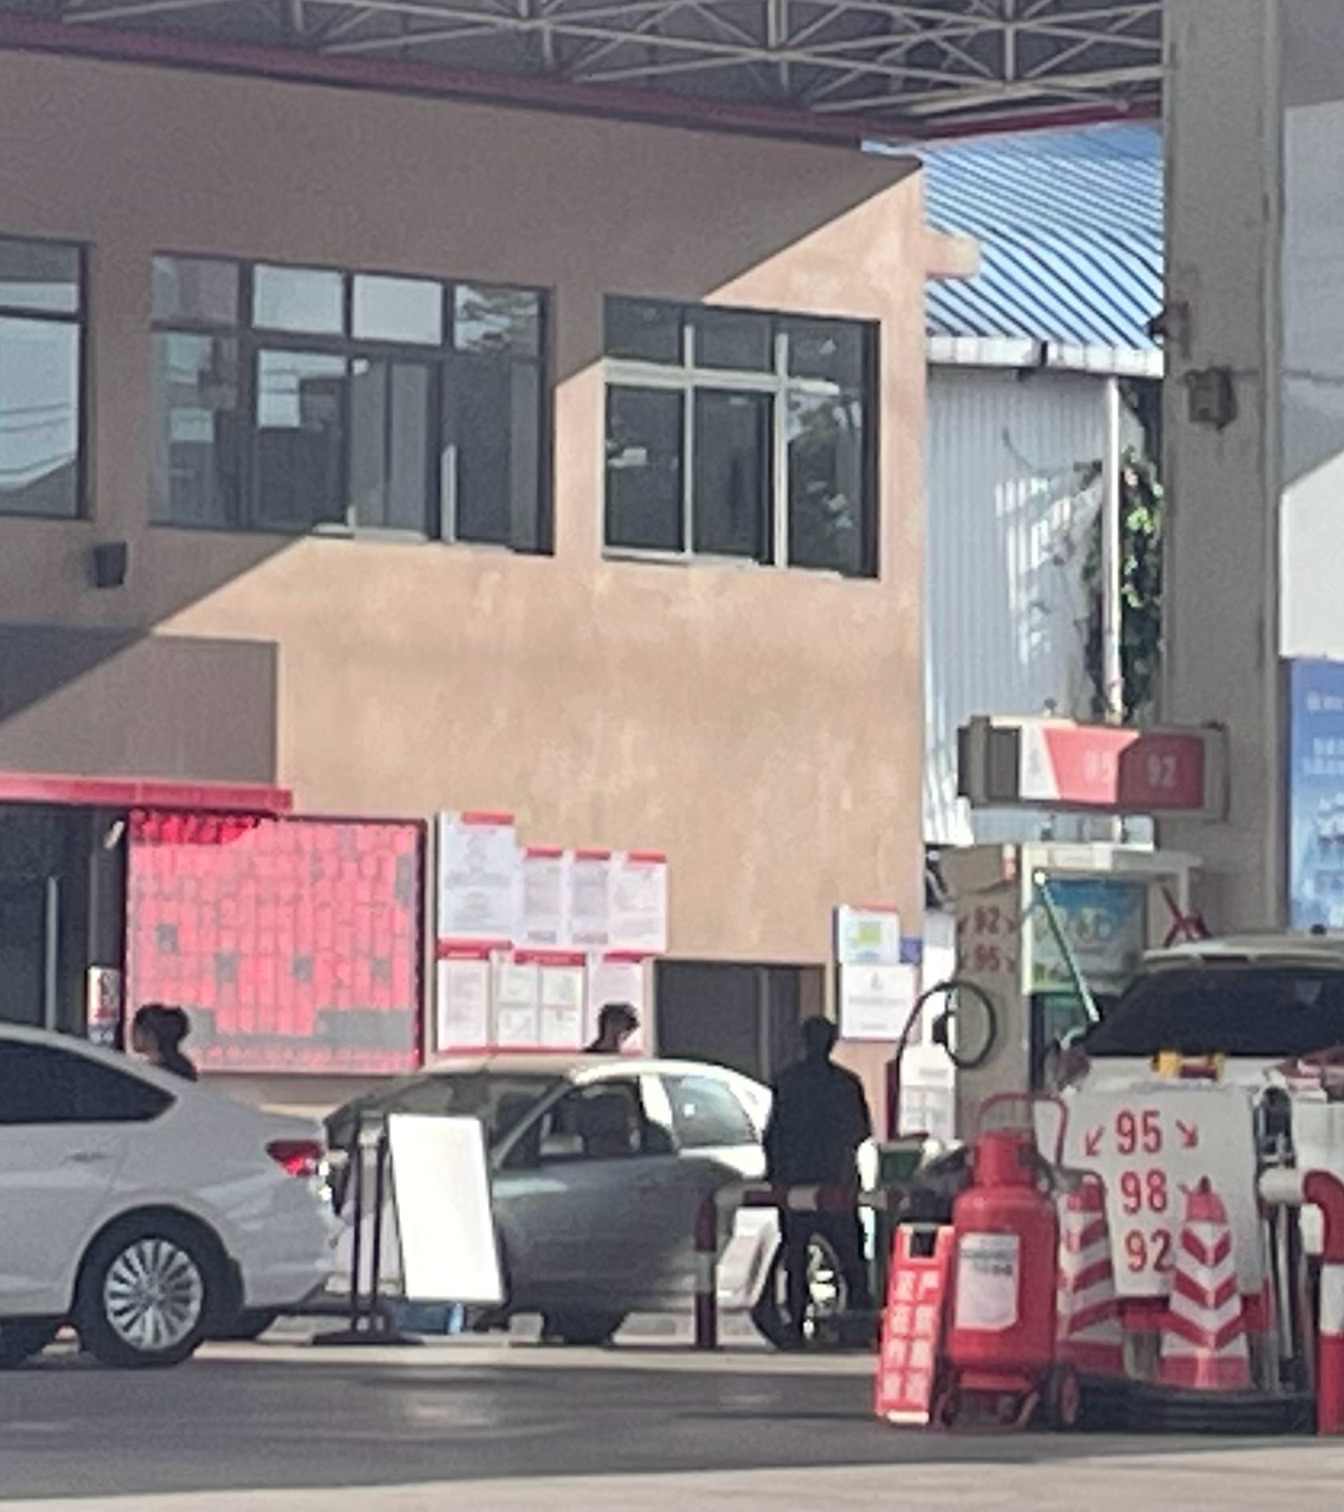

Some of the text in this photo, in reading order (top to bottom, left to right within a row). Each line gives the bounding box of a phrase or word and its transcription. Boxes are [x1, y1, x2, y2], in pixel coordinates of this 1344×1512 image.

[1146, 753, 1177, 788] 92
[973, 907, 1001, 935] 92
[1116, 1109, 1163, 1155] 95
[1120, 1168, 1168, 1215] 98
[1125, 1229, 1176, 1274] 92
